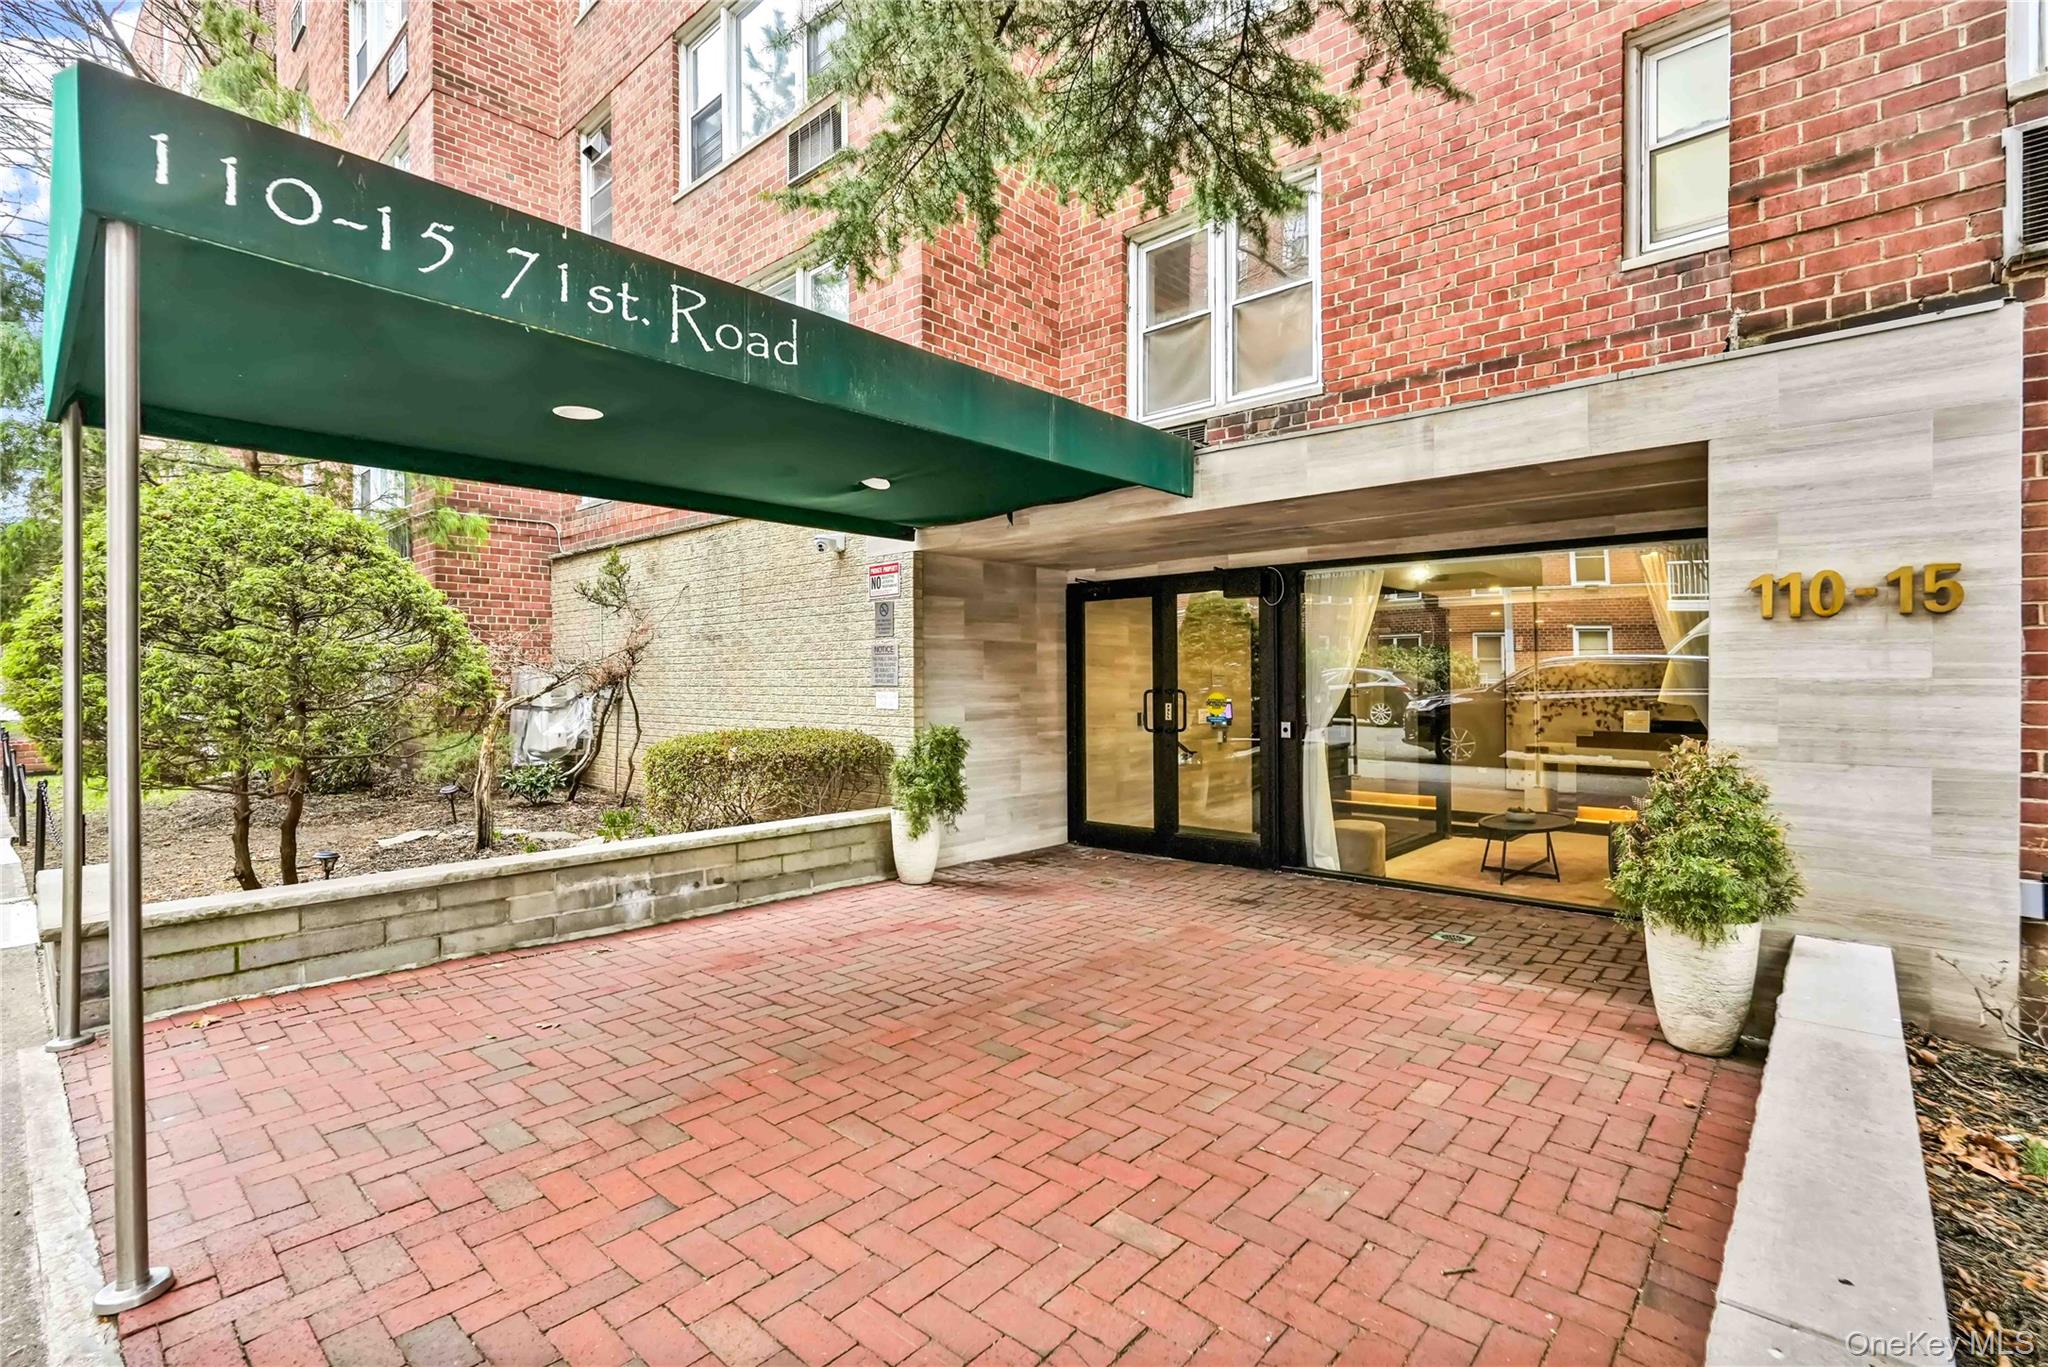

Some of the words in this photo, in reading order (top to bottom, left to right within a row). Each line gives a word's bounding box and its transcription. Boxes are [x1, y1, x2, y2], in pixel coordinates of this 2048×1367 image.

[149, 132, 455, 273] 110-15
[500, 247, 650, 327] 71st.
[670, 284, 799, 367] Road
[871, 576, 881, 590] NO
[1746, 562, 1965, 619] 110-15
[874, 645, 893, 653] NOTICE
